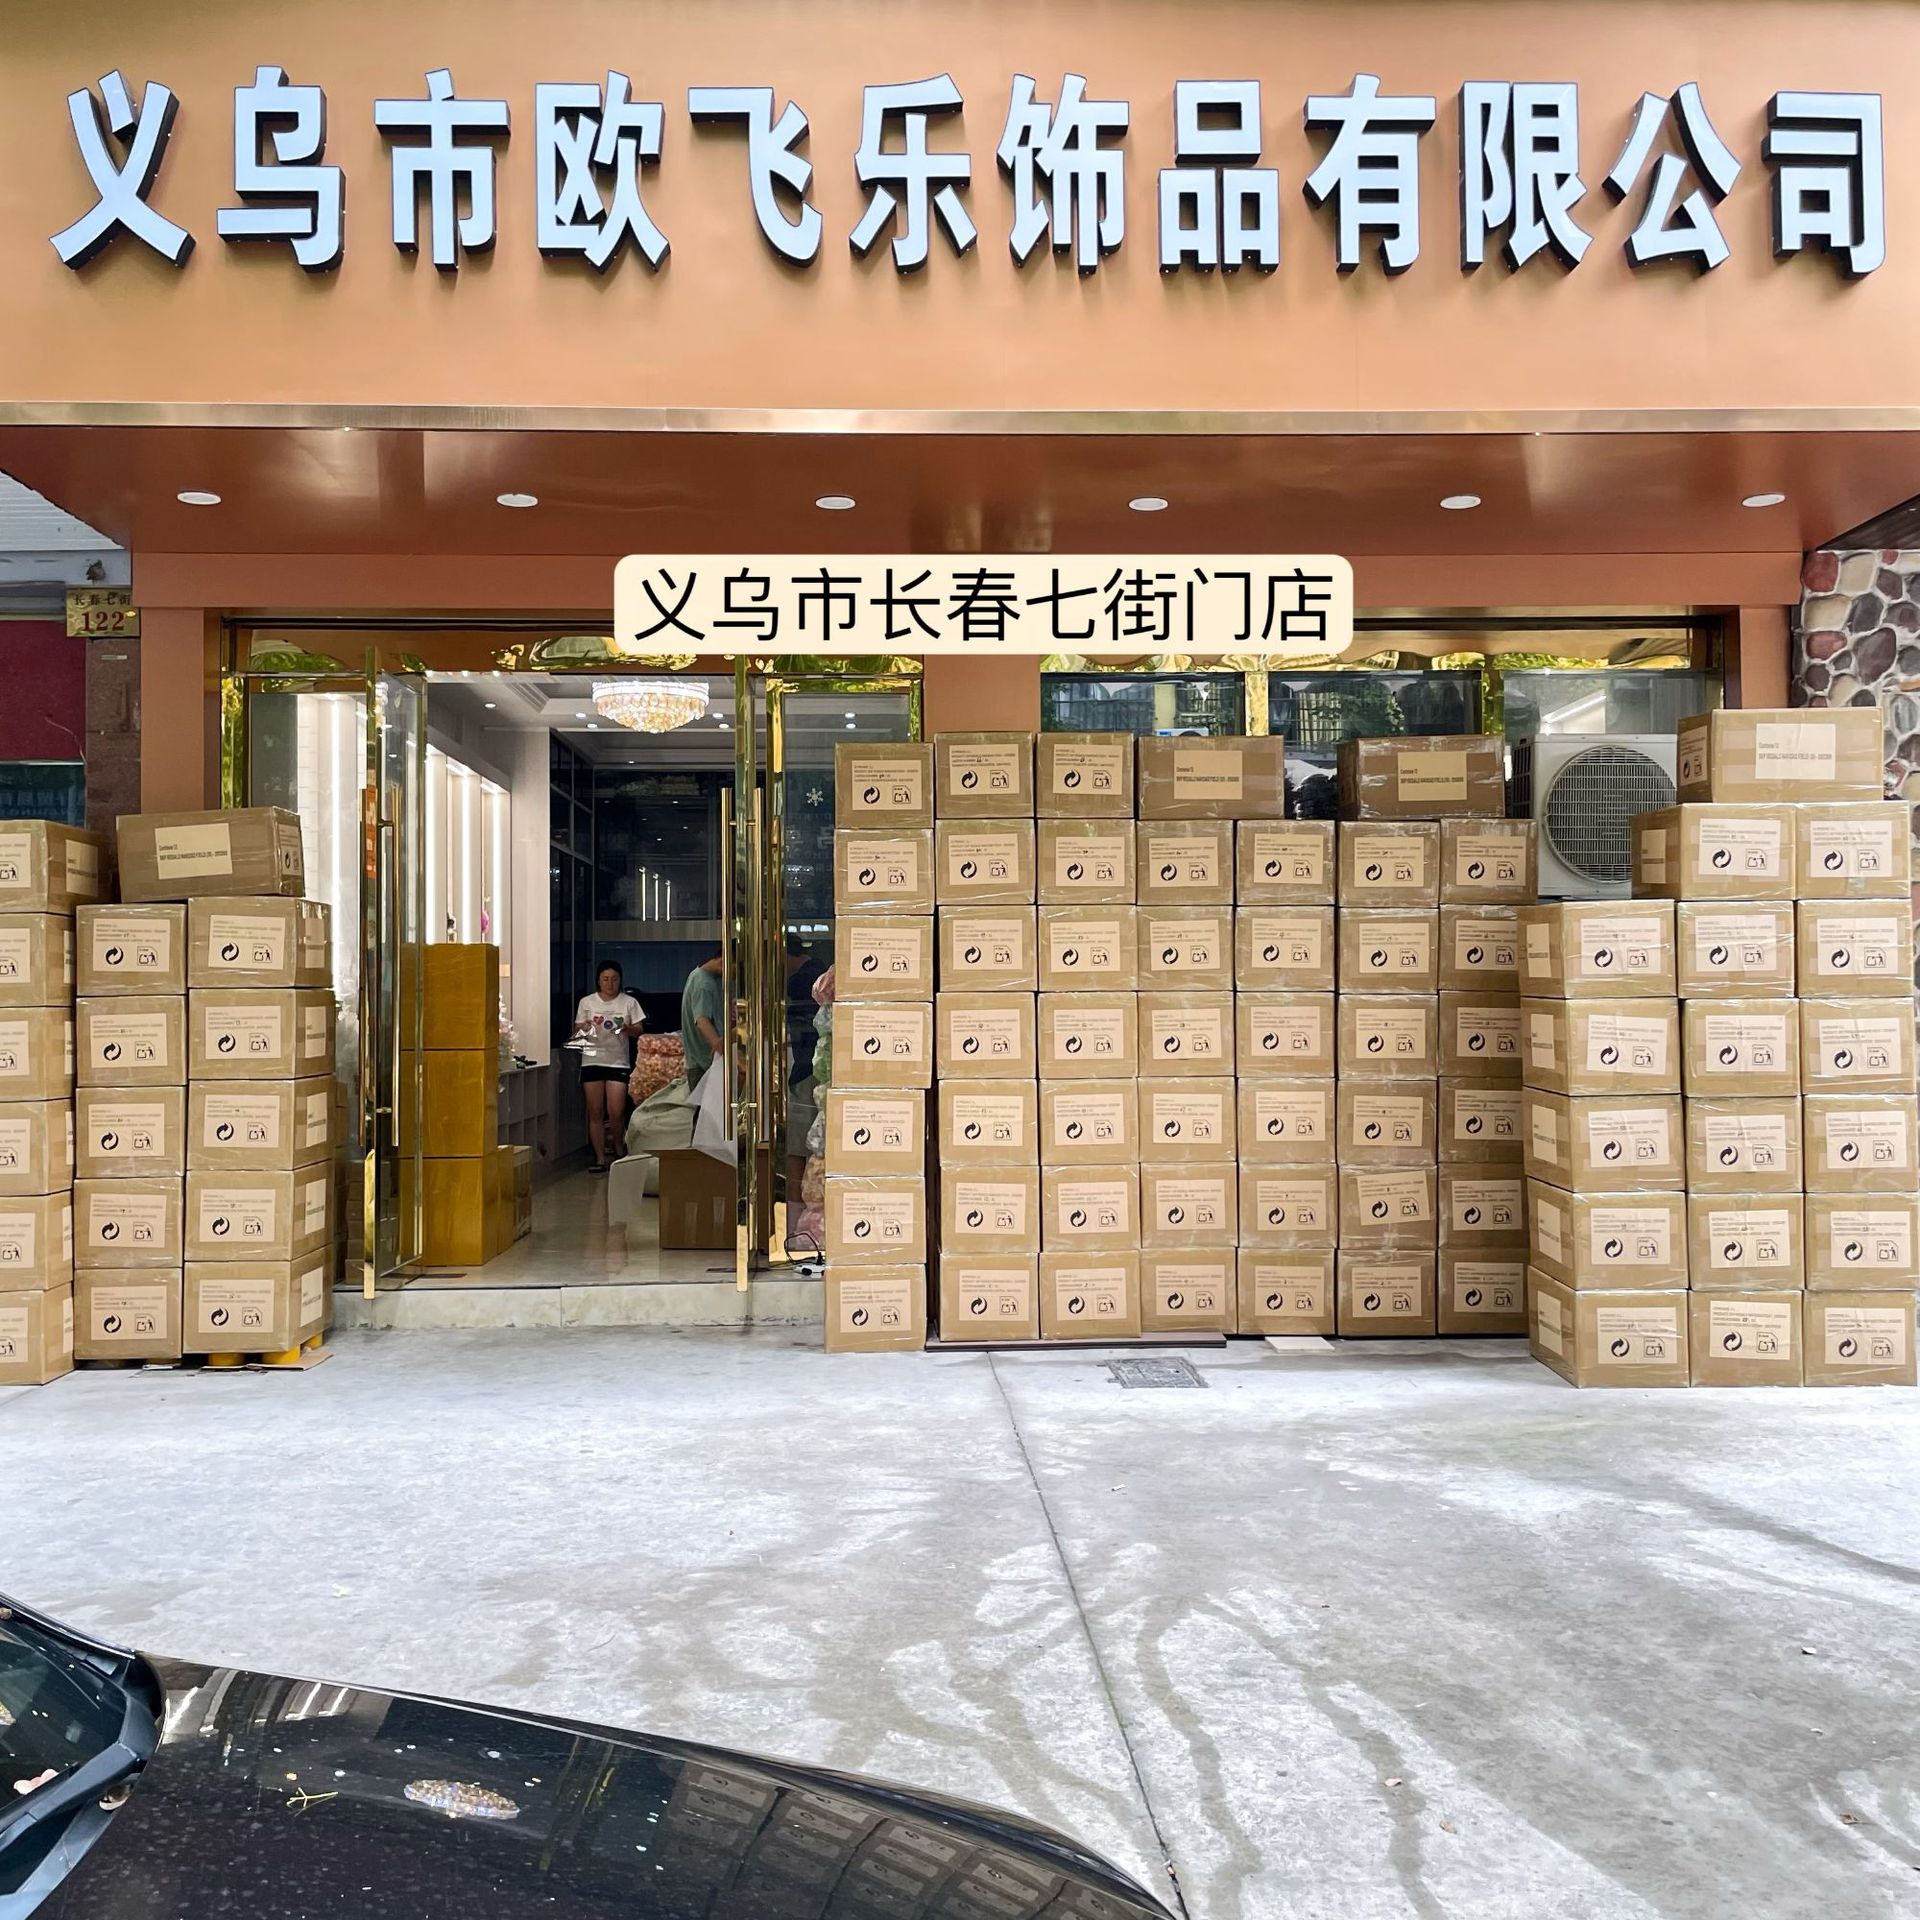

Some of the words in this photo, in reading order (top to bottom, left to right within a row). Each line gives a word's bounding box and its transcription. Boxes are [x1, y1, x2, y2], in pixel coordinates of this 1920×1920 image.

[51, 67, 1885, 273] 义乌市欧飞乐饰品有限公司
[81, 611, 125, 632] 122
